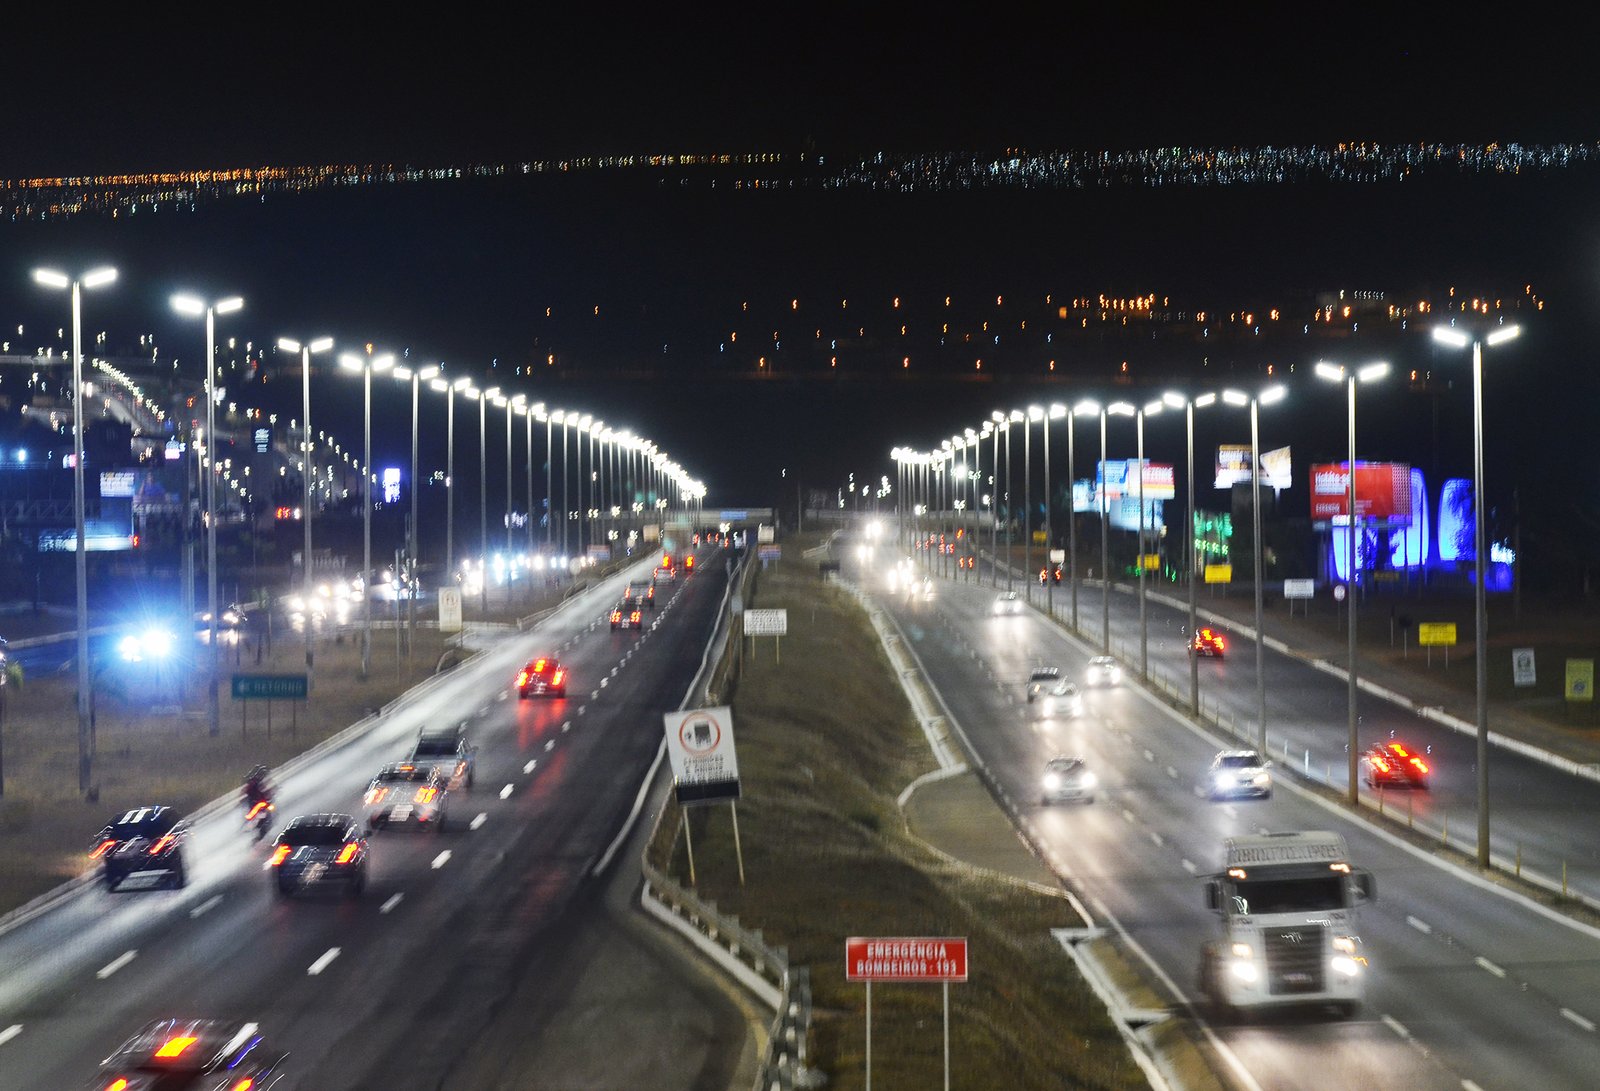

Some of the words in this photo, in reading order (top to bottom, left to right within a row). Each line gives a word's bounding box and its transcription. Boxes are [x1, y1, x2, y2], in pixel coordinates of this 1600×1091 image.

[867, 940, 946, 960] EMERGÊNCIA
[857, 959, 927, 977] BOMBEIROS
[937, 959, 957, 977] 193
